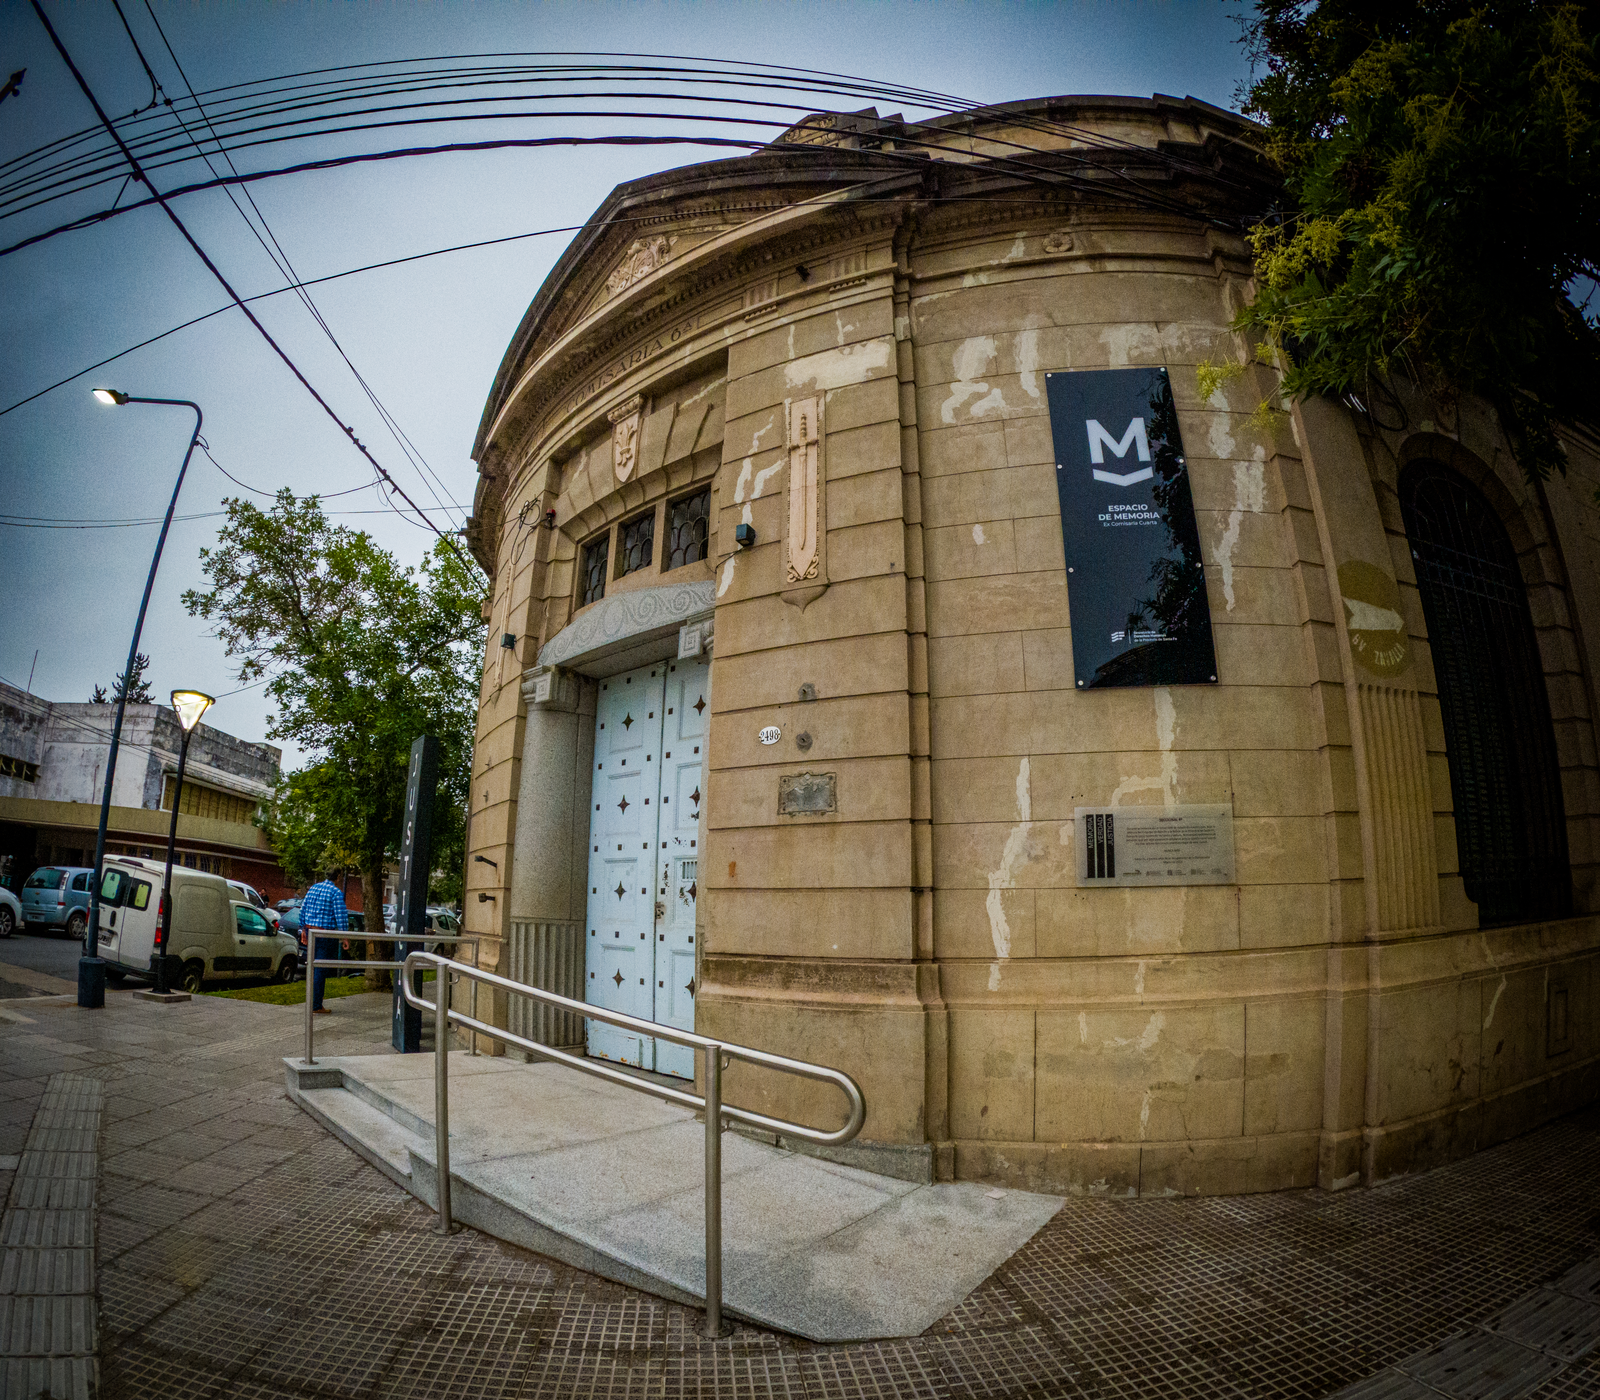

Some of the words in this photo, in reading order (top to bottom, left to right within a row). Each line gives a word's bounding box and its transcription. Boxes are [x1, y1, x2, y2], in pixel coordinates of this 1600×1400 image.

[566, 339, 664, 413] COMISARIA
[1108, 504, 1148, 512] ESPACIO
[1098, 513, 1112, 521] DE
[1114, 511, 1160, 520] MEMORIA
[760, 729, 779, 742] 2498
